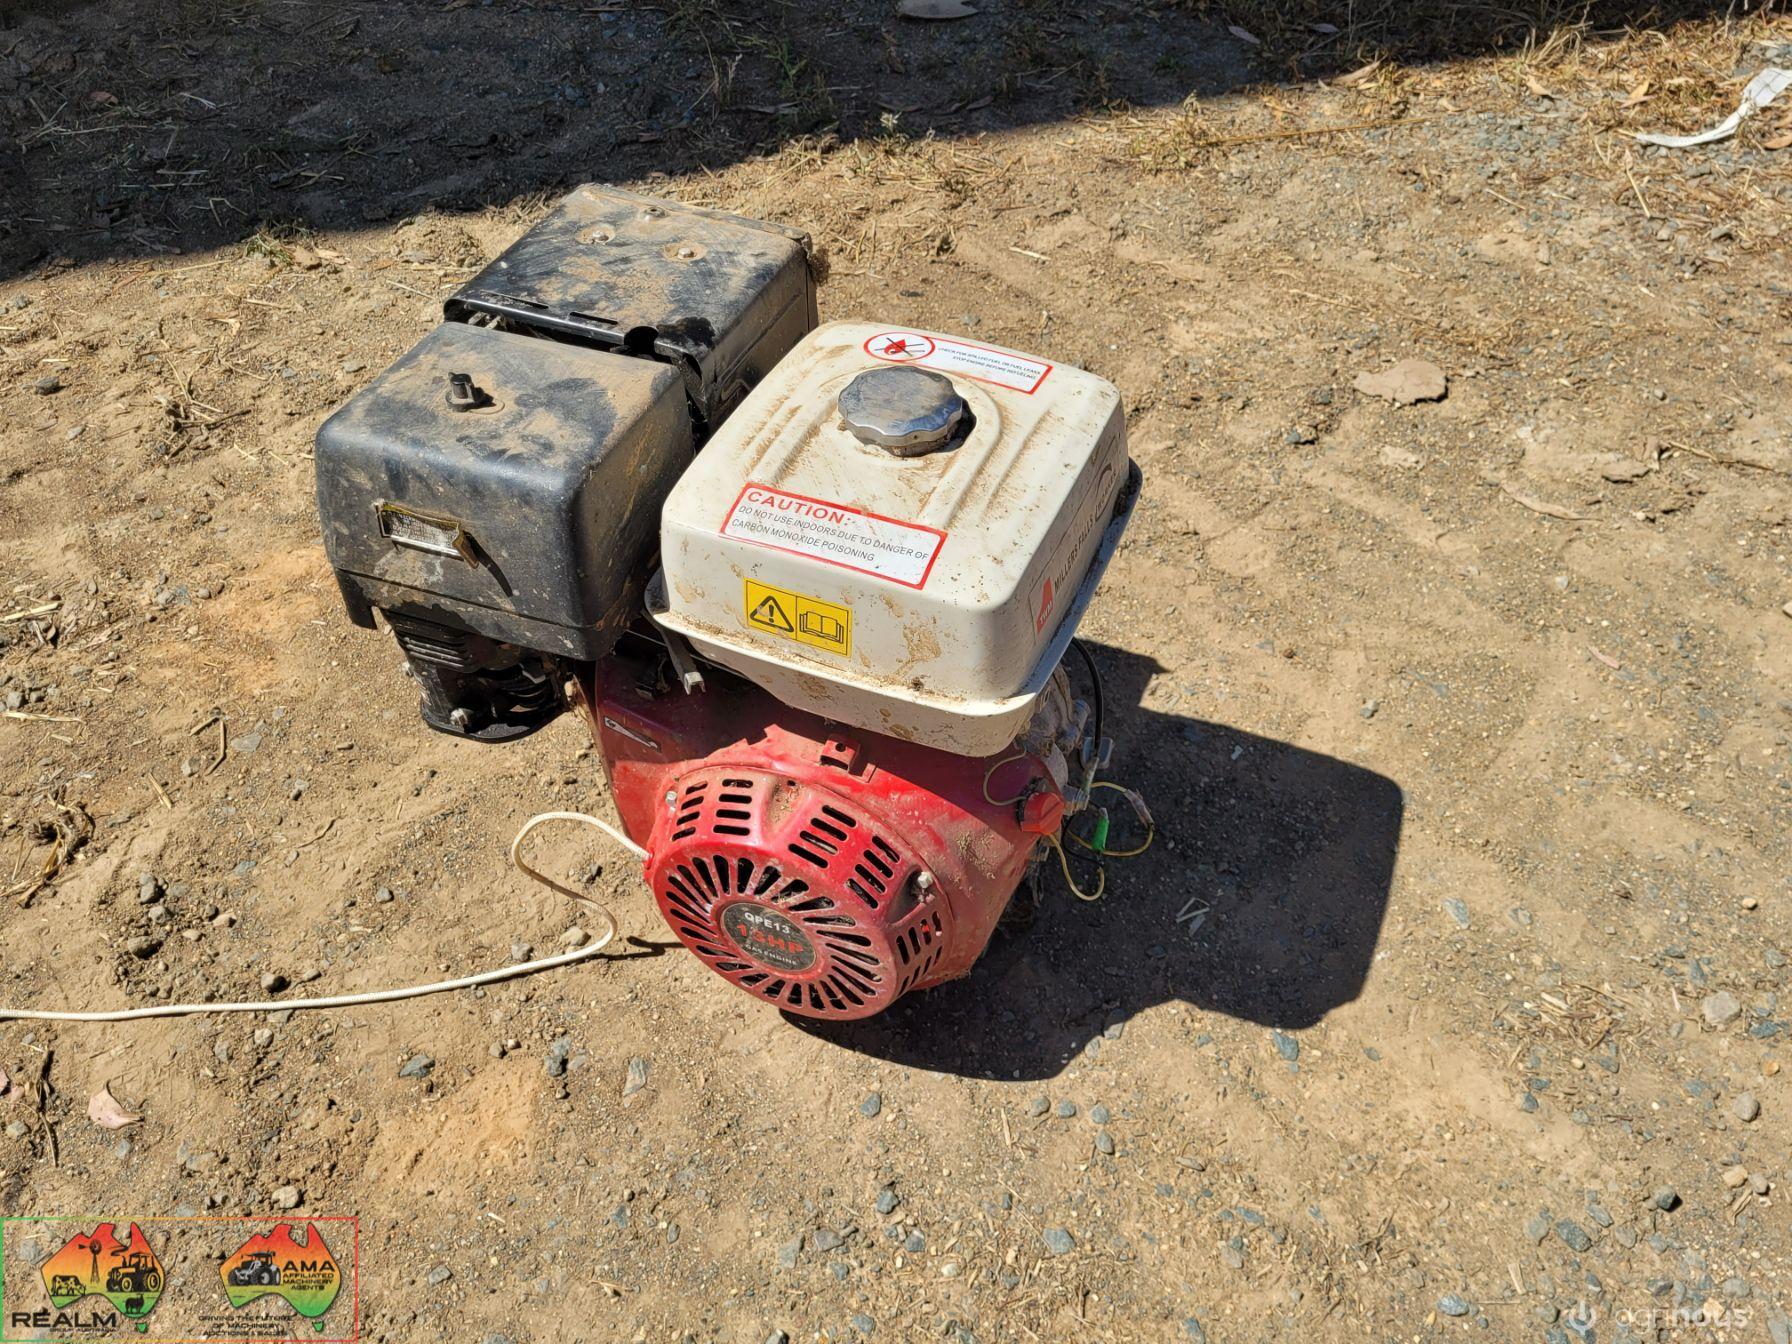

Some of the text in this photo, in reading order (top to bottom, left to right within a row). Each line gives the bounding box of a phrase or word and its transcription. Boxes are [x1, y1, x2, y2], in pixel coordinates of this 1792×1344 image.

[731, 518, 876, 561] CARBON MONOXIDE POISONING
[739, 505, 930, 560] DO NOT USE INDOORS DUE TO DANGER OF
[1053, 513, 1095, 595] MILLERS FALLS
[744, 911, 791, 934] QPE13
[763, 950, 798, 966] ENGINE
